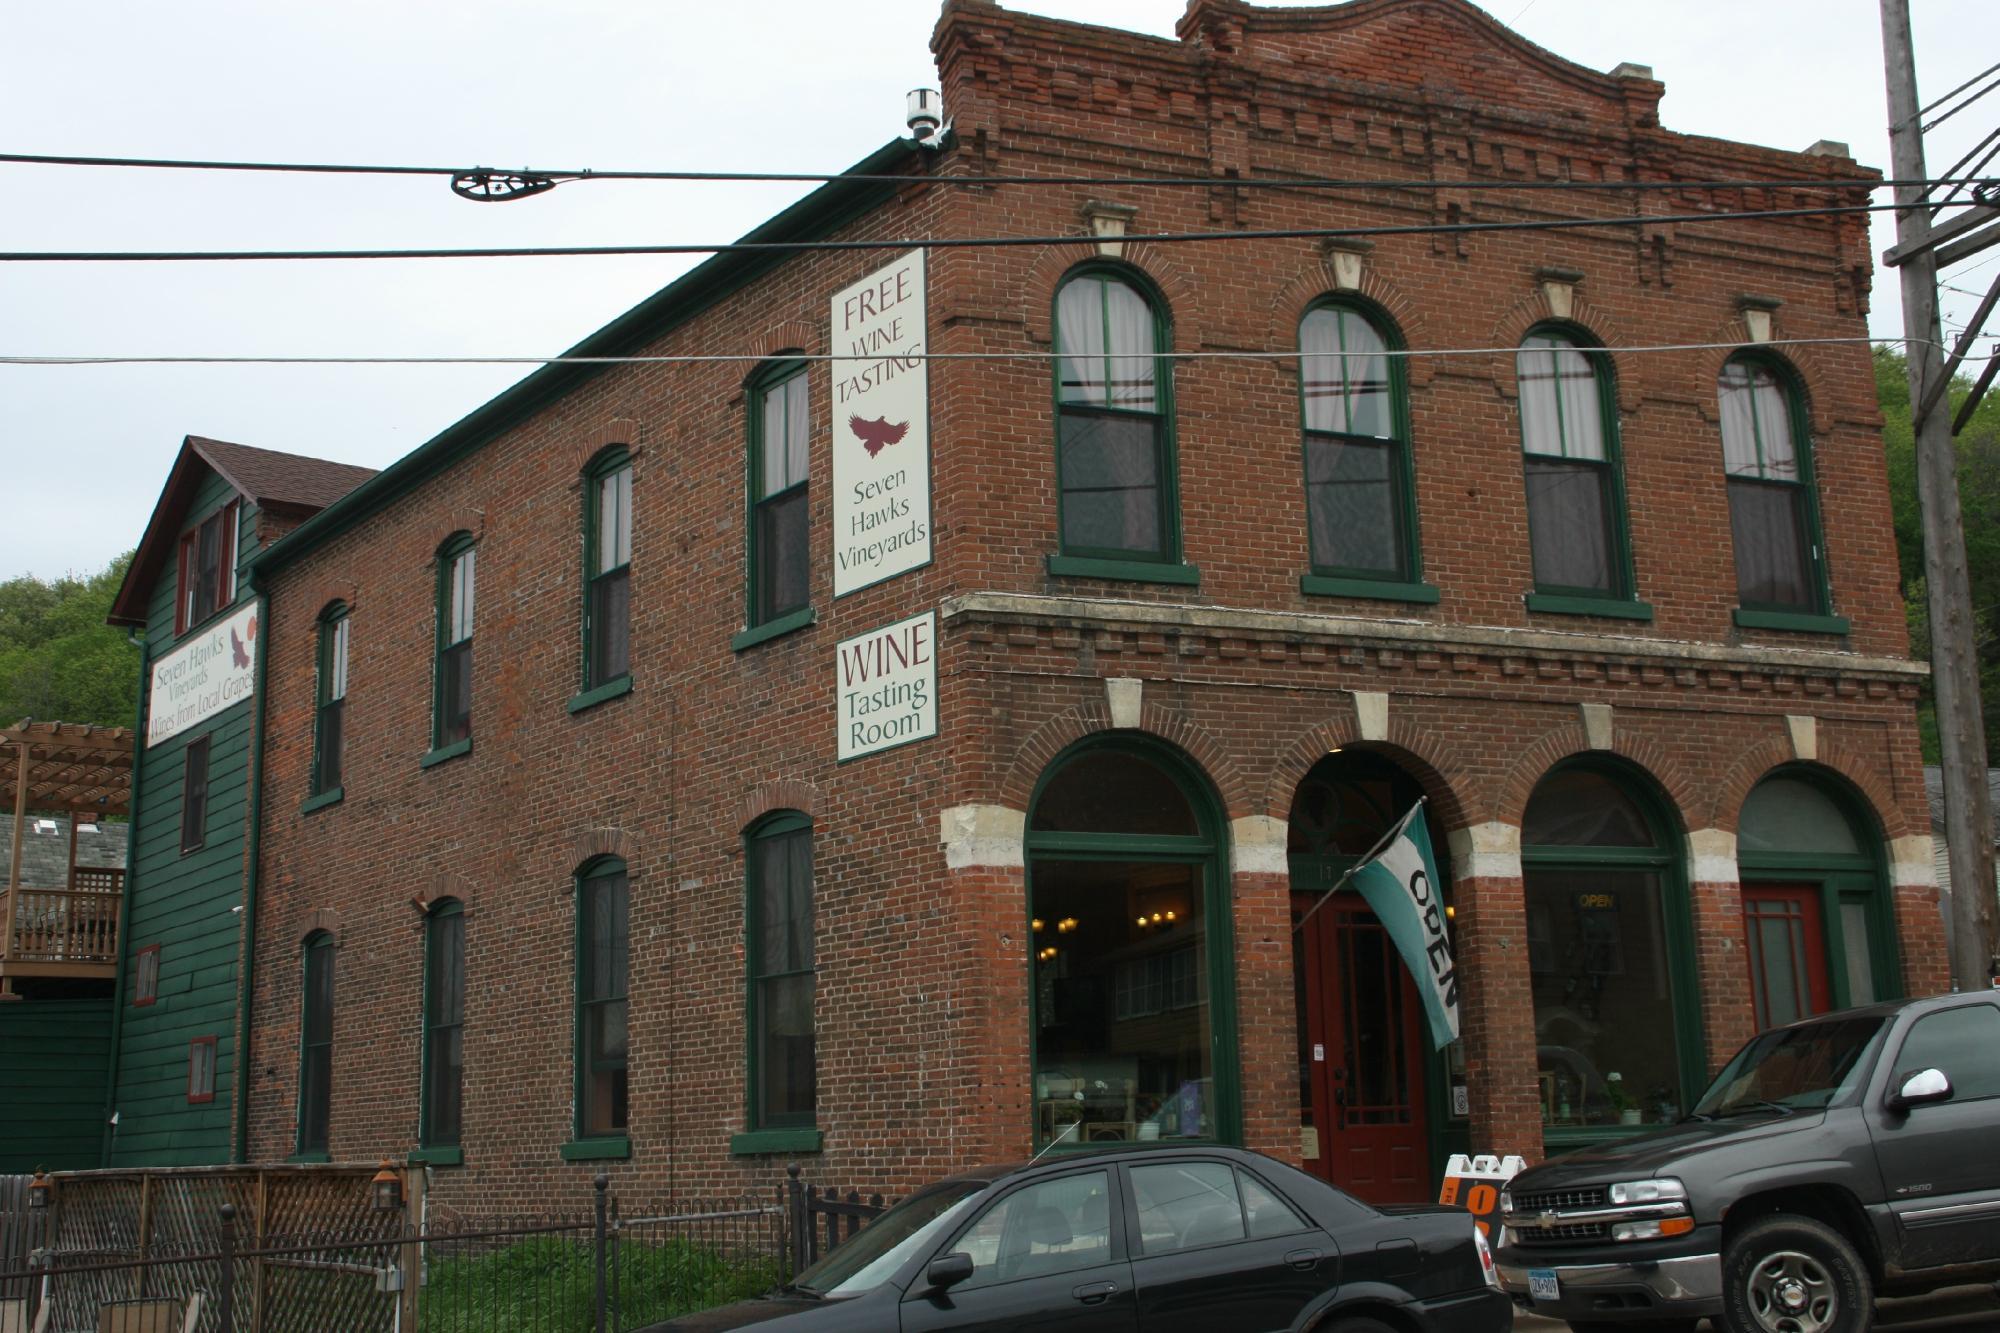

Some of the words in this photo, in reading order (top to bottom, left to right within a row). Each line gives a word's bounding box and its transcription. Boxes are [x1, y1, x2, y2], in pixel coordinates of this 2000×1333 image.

[844, 267, 912, 331] FREE
[852, 317, 904, 361] WINE
[836, 343, 921, 404] TASTING
[853, 469, 906, 505] Seven
[851, 497, 909, 536] Hawks
[838, 520, 926, 571] Vineyards
[156, 659, 186, 690] Seven
[189, 633, 224, 671] Hawks
[842, 621, 930, 687] WINE
[150, 713, 175, 739] Wines
[177, 702, 196, 727] from
[198, 681, 220, 715] Local
[223, 671, 255, 700] Grapes
[168, 667, 209, 702] Vineyards
[845, 677, 928, 718] Tasting
[851, 712, 921, 749] Room
[1579, 894, 1615, 907] OPEN
[1409, 869, 1457, 1008] OPEN
